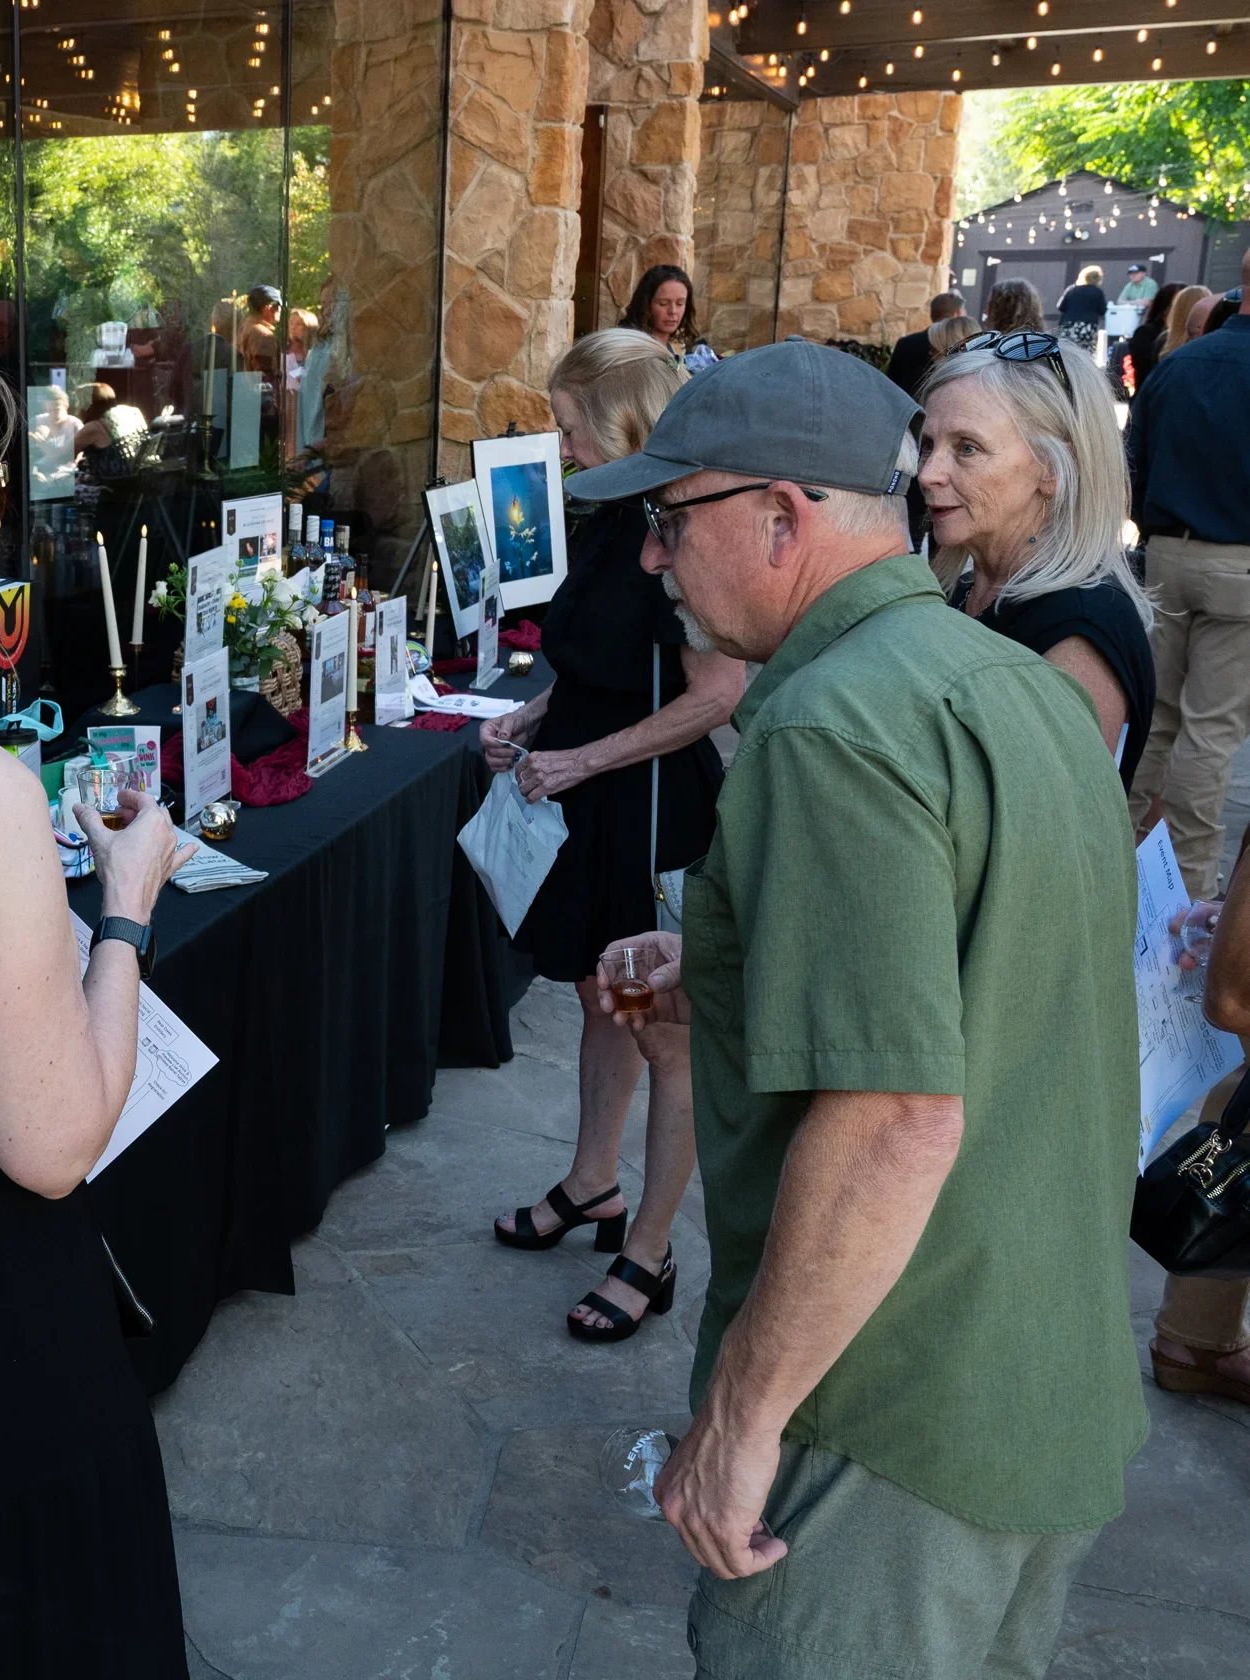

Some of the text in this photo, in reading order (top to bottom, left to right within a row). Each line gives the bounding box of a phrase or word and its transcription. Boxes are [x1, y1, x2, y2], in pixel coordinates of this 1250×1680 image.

[138, 752, 155, 761] DINK
[1157, 839, 1174, 890] Event Map
[164, 1027, 172, 1036] Creek
